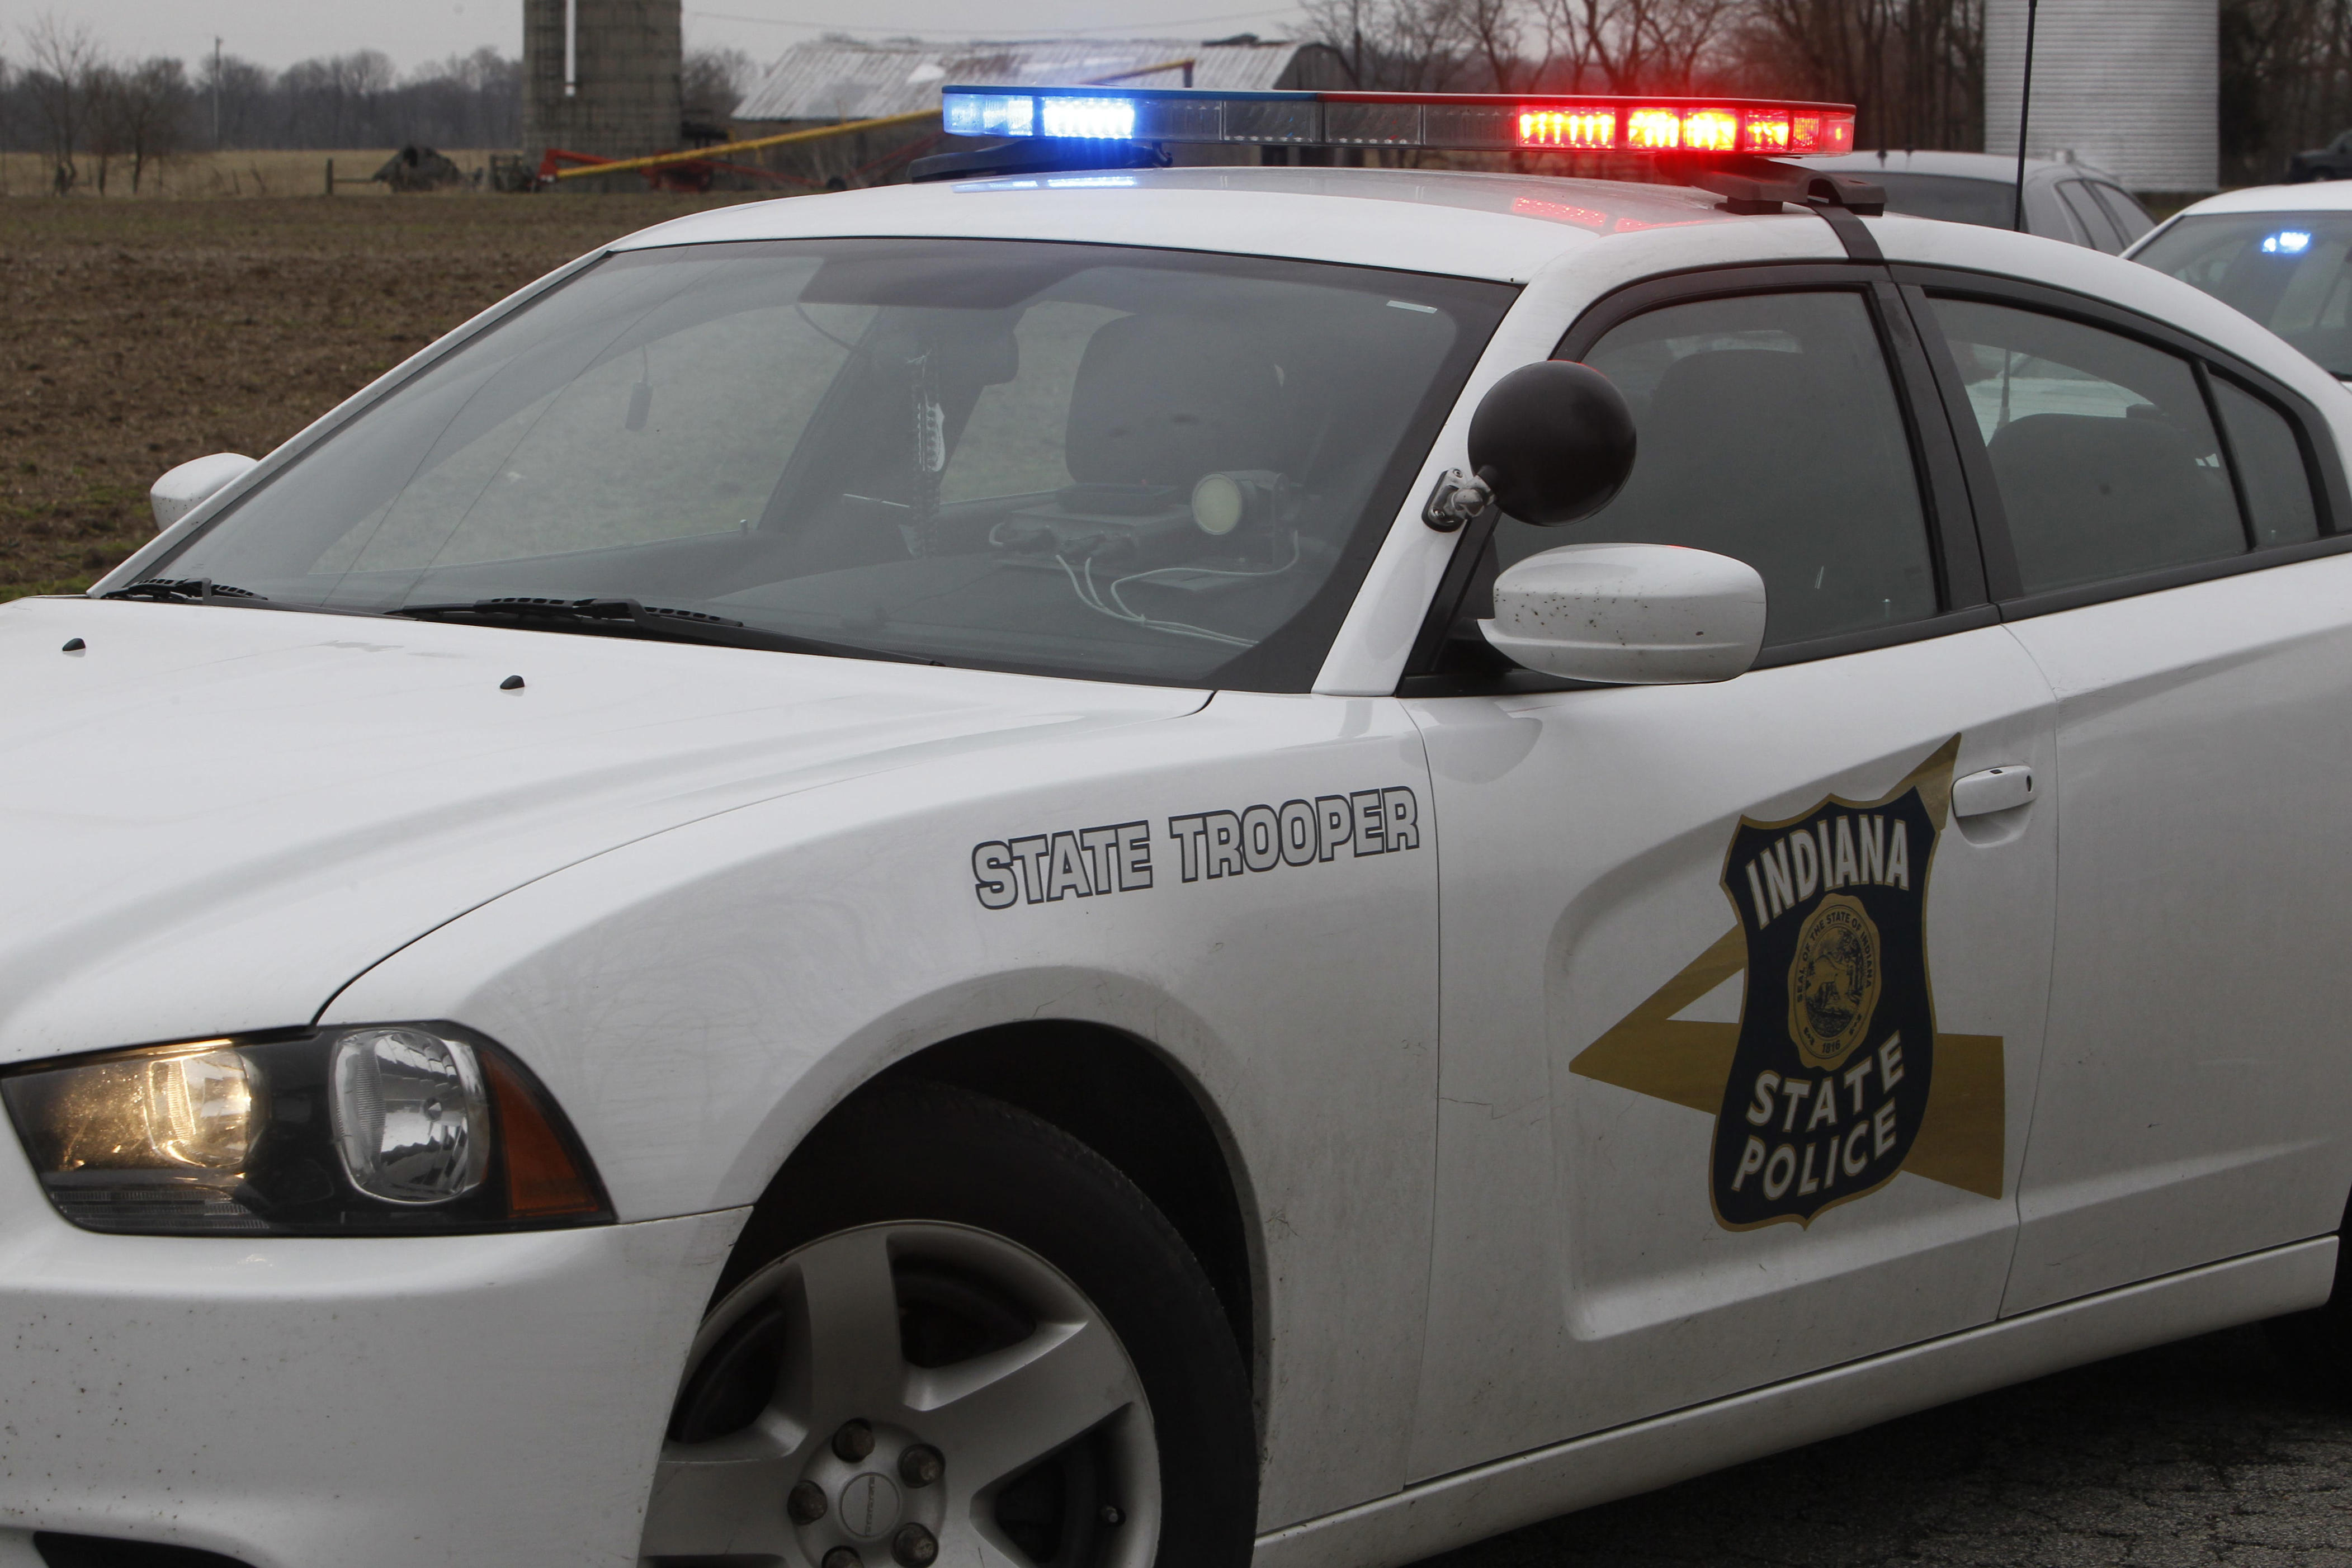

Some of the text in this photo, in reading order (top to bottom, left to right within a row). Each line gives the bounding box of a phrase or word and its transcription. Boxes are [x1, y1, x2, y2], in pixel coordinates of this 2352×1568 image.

[972, 786, 1420, 910] STATE TROOPER
[1745, 814, 1909, 931] INDIANA
[1803, 943, 1811, 960] OF
[1810, 920, 1825, 941] THE
[1826, 911, 1851, 924] STATE
[1852, 917, 1862, 932] OF
[1860, 931, 1872, 988] INDIANA
[1746, 1029, 1904, 1132] STATE
[1822, 1039, 1840, 1054] 1816
[1731, 1097, 1896, 1201] POLICE
